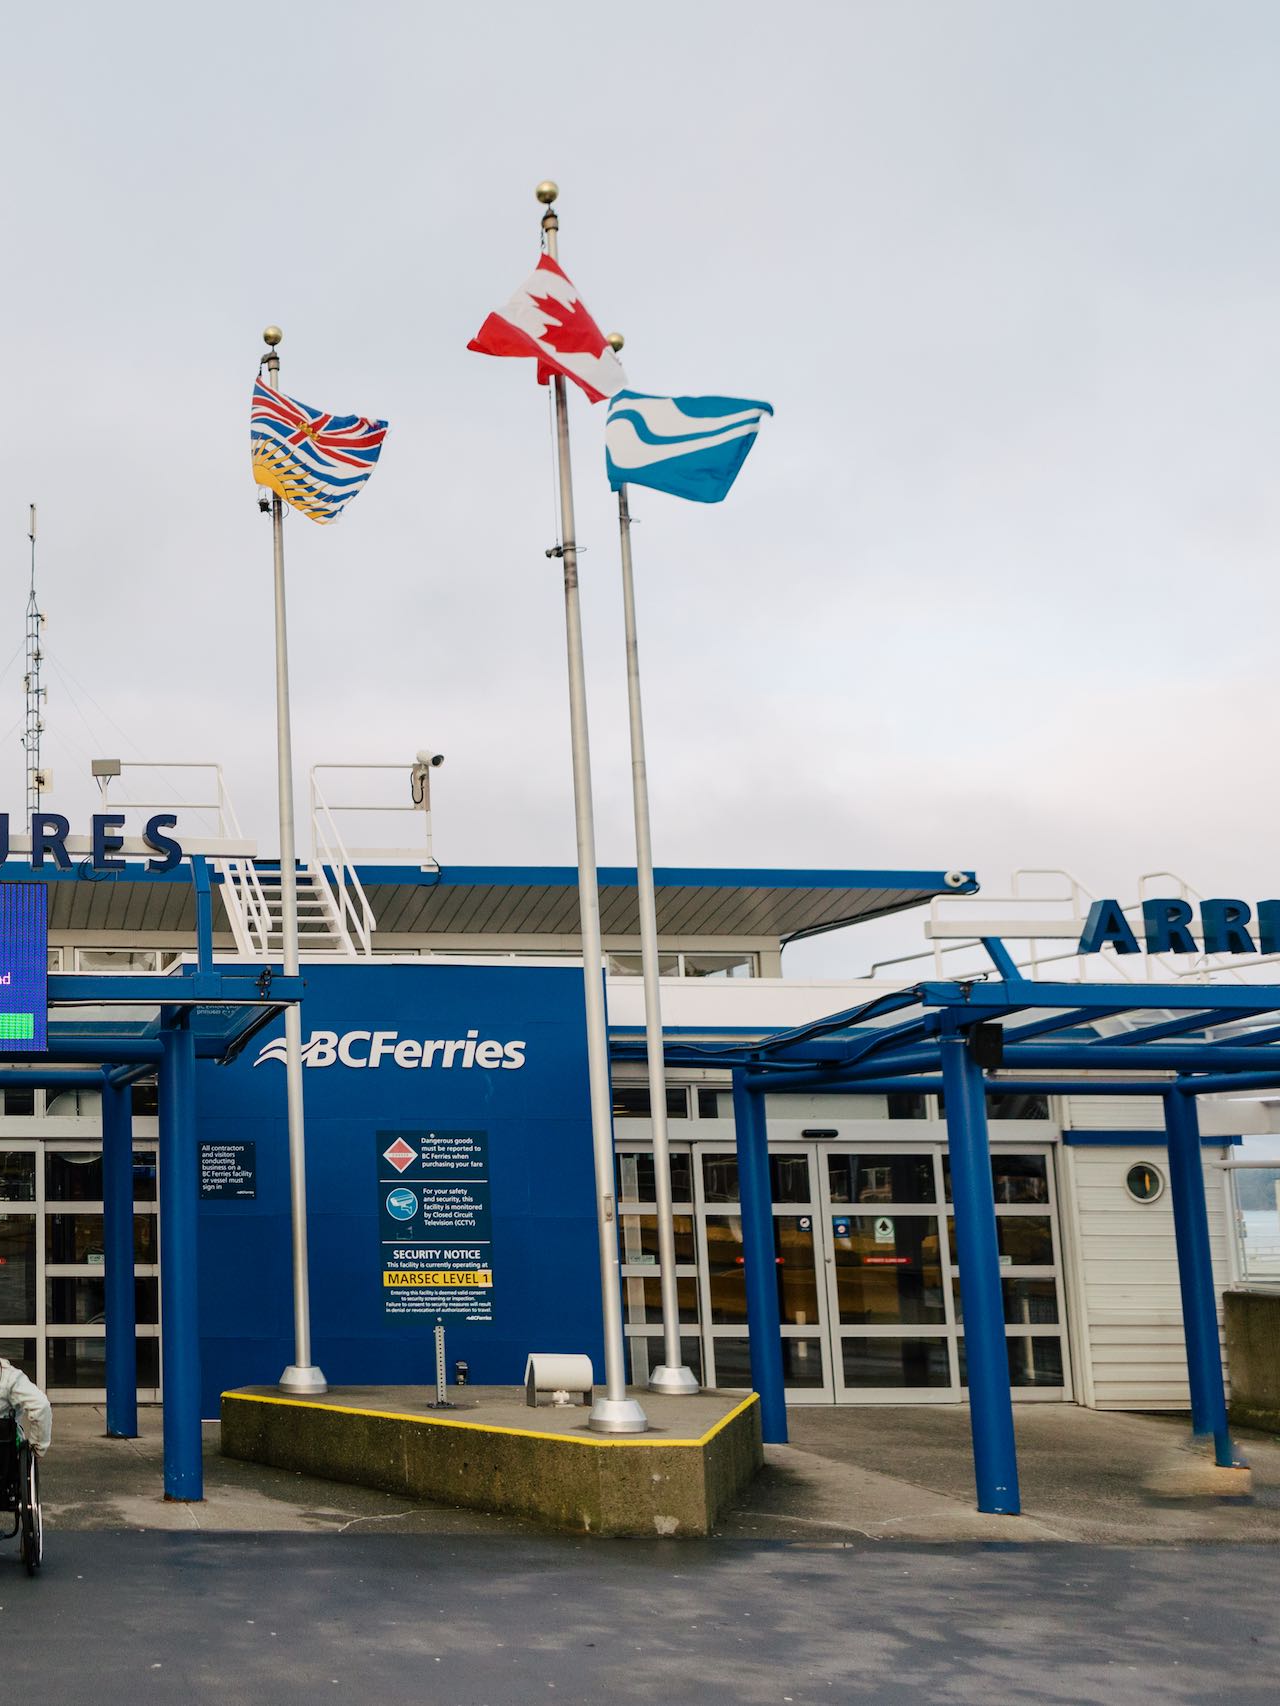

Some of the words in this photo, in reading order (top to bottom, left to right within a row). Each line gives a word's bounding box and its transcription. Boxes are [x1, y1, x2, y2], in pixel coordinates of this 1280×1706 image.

[305, 1030, 526, 1069] BCFerries
[449, 1188, 468, 1196] safety
[393, 1250, 441, 1259] SECURITY
[444, 1250, 481, 1259] NOTICE
[388, 1274, 440, 1284] MARSEC
[444, 1274, 478, 1284] LEVEL
[482, 1274, 488, 1284] 1
